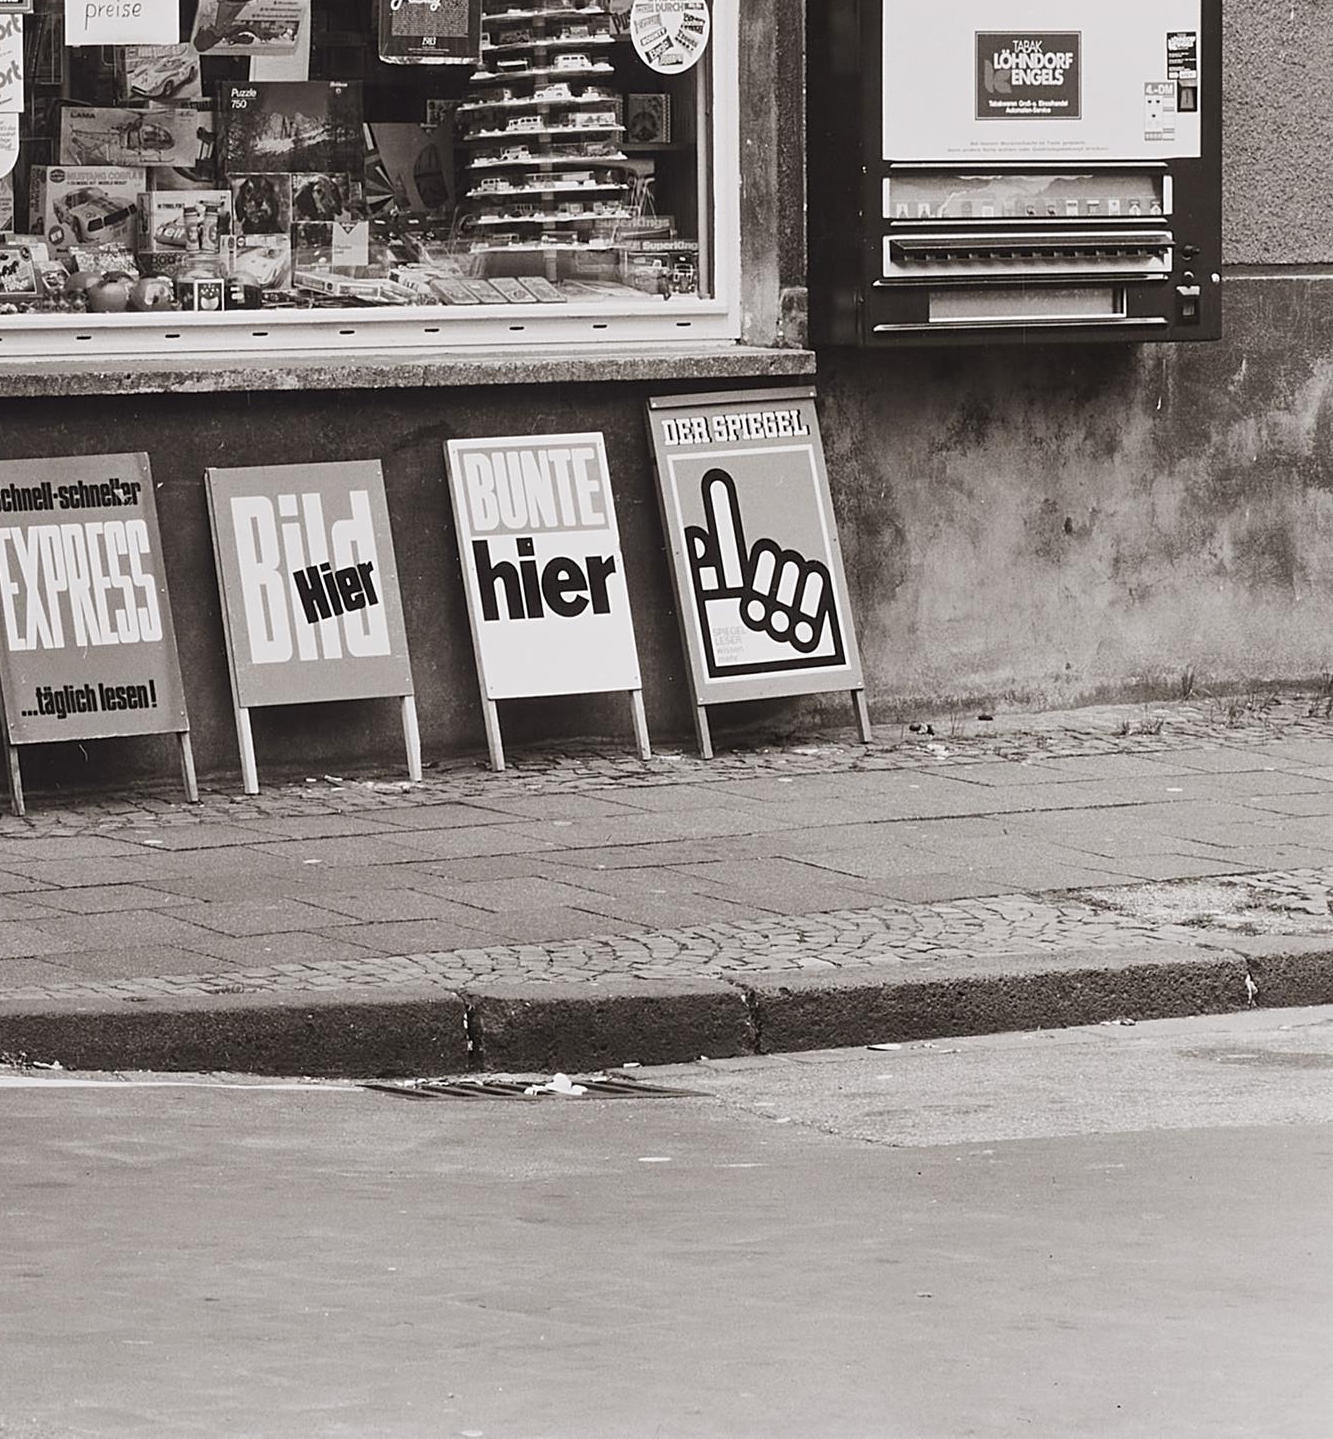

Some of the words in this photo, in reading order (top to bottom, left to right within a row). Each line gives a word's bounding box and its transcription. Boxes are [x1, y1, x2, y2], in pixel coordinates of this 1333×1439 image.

[84, 0, 142, 31] preise
[655, 3, 684, 12] DURCH
[1013, 40, 1043, 53] TABAK
[994, 49, 1073, 69] LÖHNDORF
[1012, 69, 1064, 85] ENGELS
[231, 87, 257, 99] Puzzle
[231, 99, 247, 109] 750
[661, 417, 711, 446] DER
[714, 408, 809, 443] SPIEGEL
[463, 446, 606, 531] BUNTE
[230, 489, 392, 664] Bild
[472, 537, 617, 622] hier
[293, 560, 380, 625] Hier
[713, 626, 747, 637] SPIEGEL
[715, 634, 743, 645] LESER
[21, 684, 97, 720] ...täglich
[98, 680, 157, 712] lesen!
